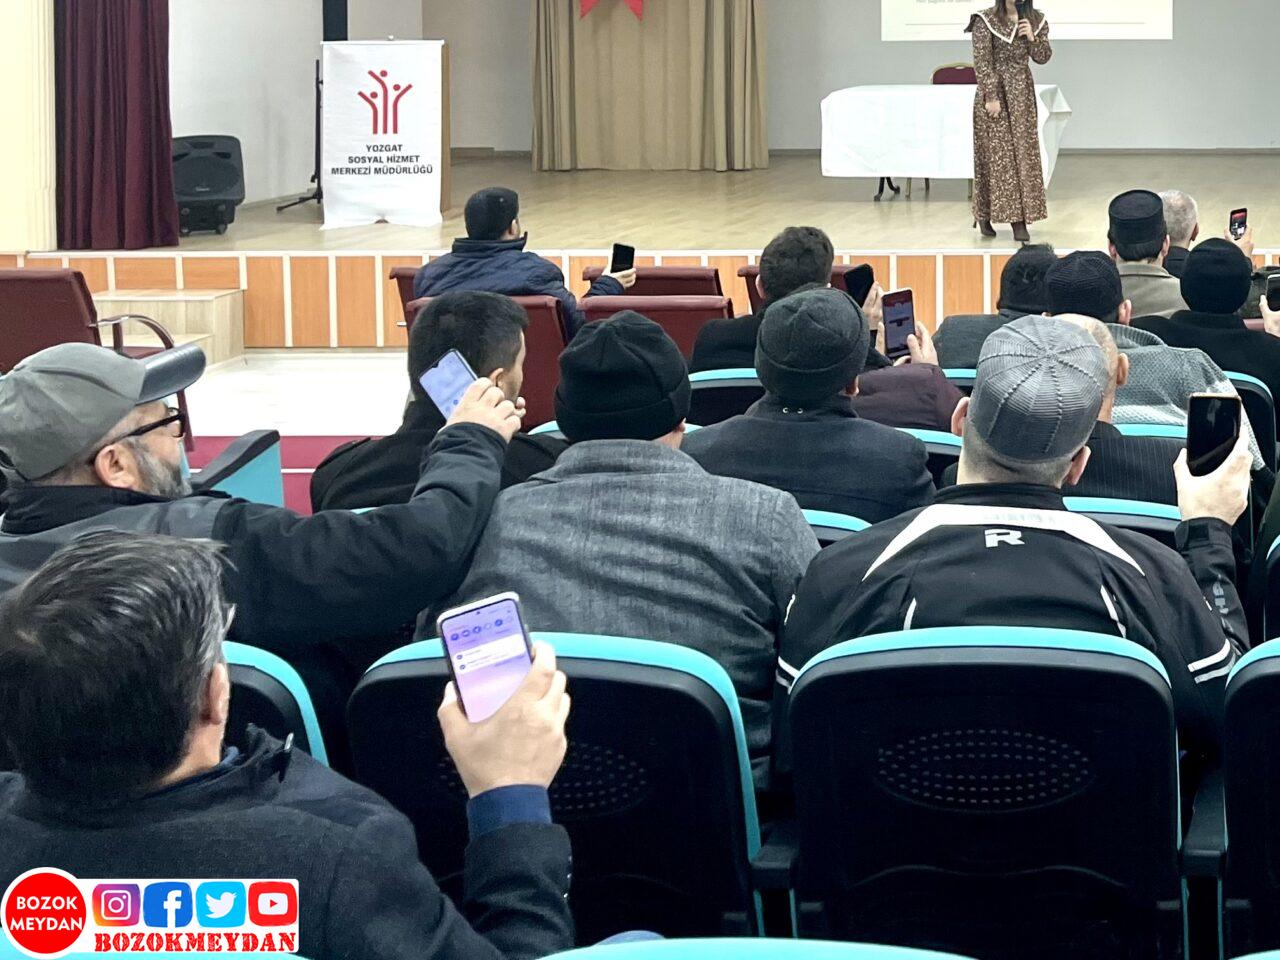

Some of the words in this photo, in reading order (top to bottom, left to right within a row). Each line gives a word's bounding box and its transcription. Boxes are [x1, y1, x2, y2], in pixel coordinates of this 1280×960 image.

[366, 144, 403, 152] YOZGAT
[386, 154, 420, 163] HİZMET
[331, 166, 371, 175] MERKEZİ
[374, 165, 433, 175] MÜDÜRLÜĞÜ
